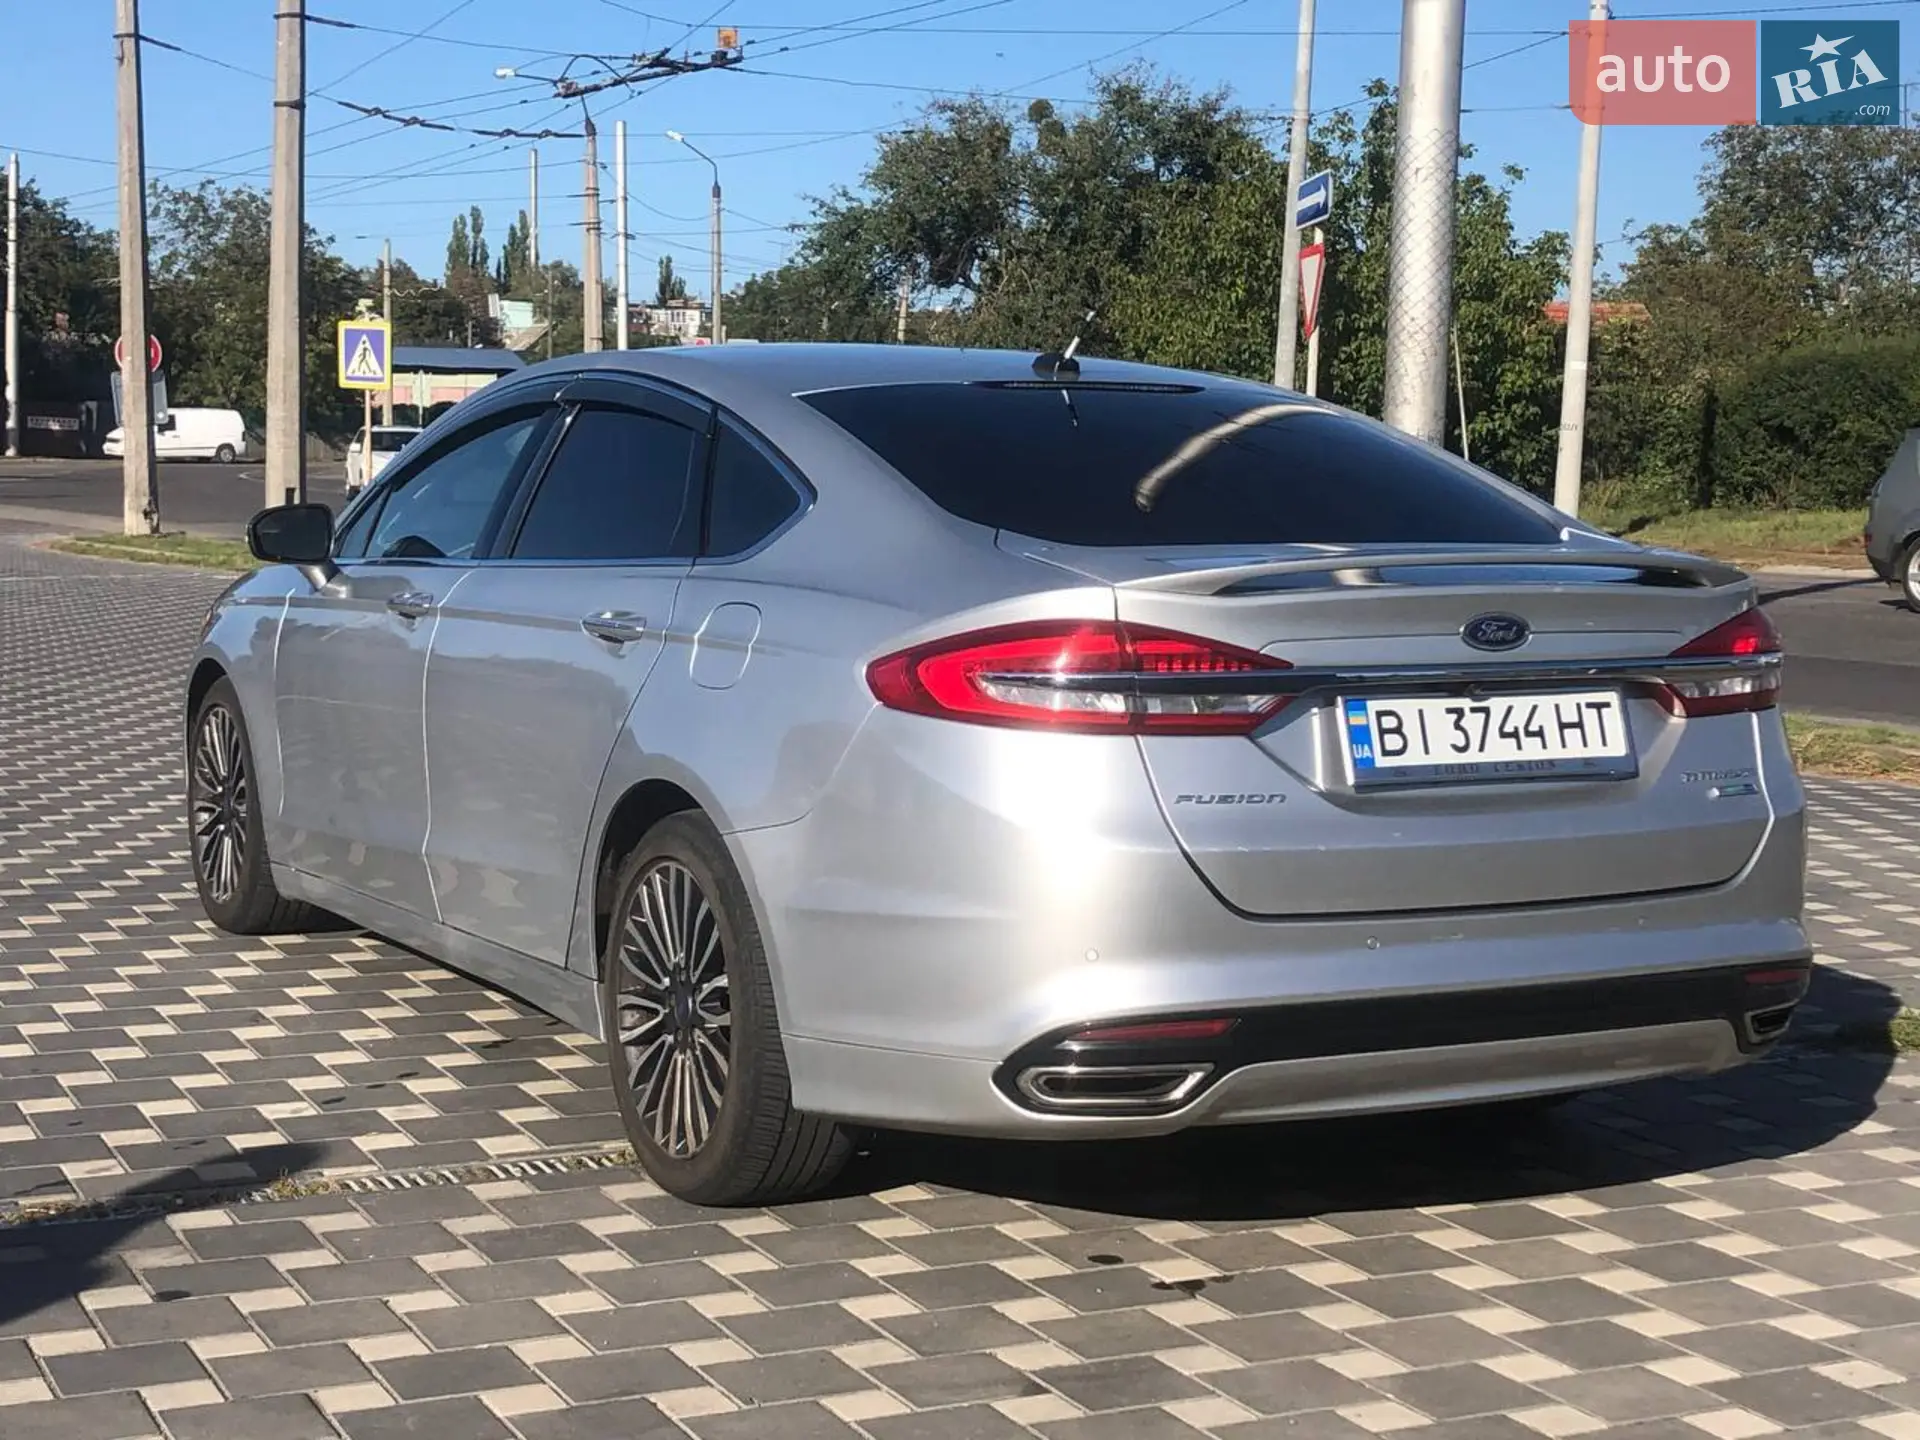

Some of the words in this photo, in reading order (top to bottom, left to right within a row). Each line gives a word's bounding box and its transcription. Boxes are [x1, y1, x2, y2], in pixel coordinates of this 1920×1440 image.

[1477, 620, 1518, 641] Ford
[1374, 707, 1431, 757] BI
[1445, 703, 1548, 754] 3744
[1554, 701, 1612, 749] HT
[1352, 743, 1373, 759] UA
[1174, 793, 1287, 805] FUSION
